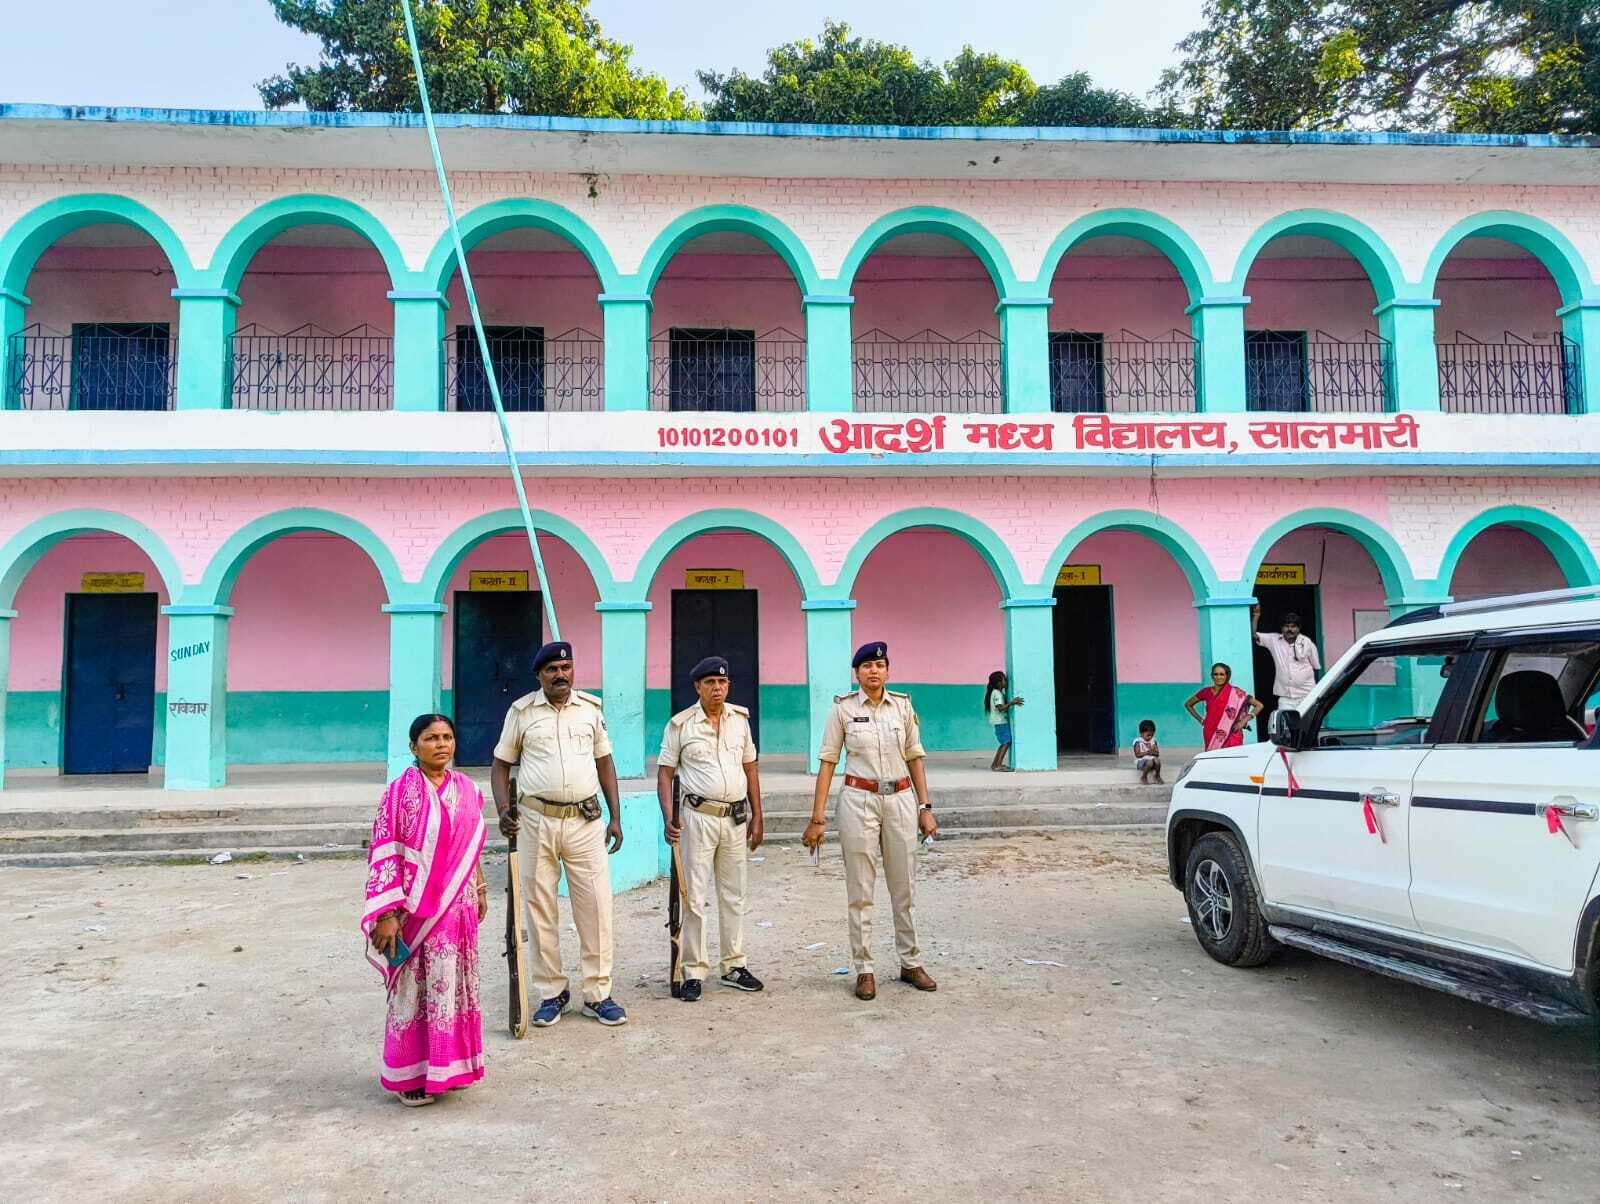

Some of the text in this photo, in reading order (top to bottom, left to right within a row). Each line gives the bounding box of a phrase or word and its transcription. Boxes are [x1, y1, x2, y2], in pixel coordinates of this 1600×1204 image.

[657, 413, 1420, 454] 10101200101 आदर्श मध्य विद्यालय, सालमारी
[170, 641, 210, 661] SUNDAY
